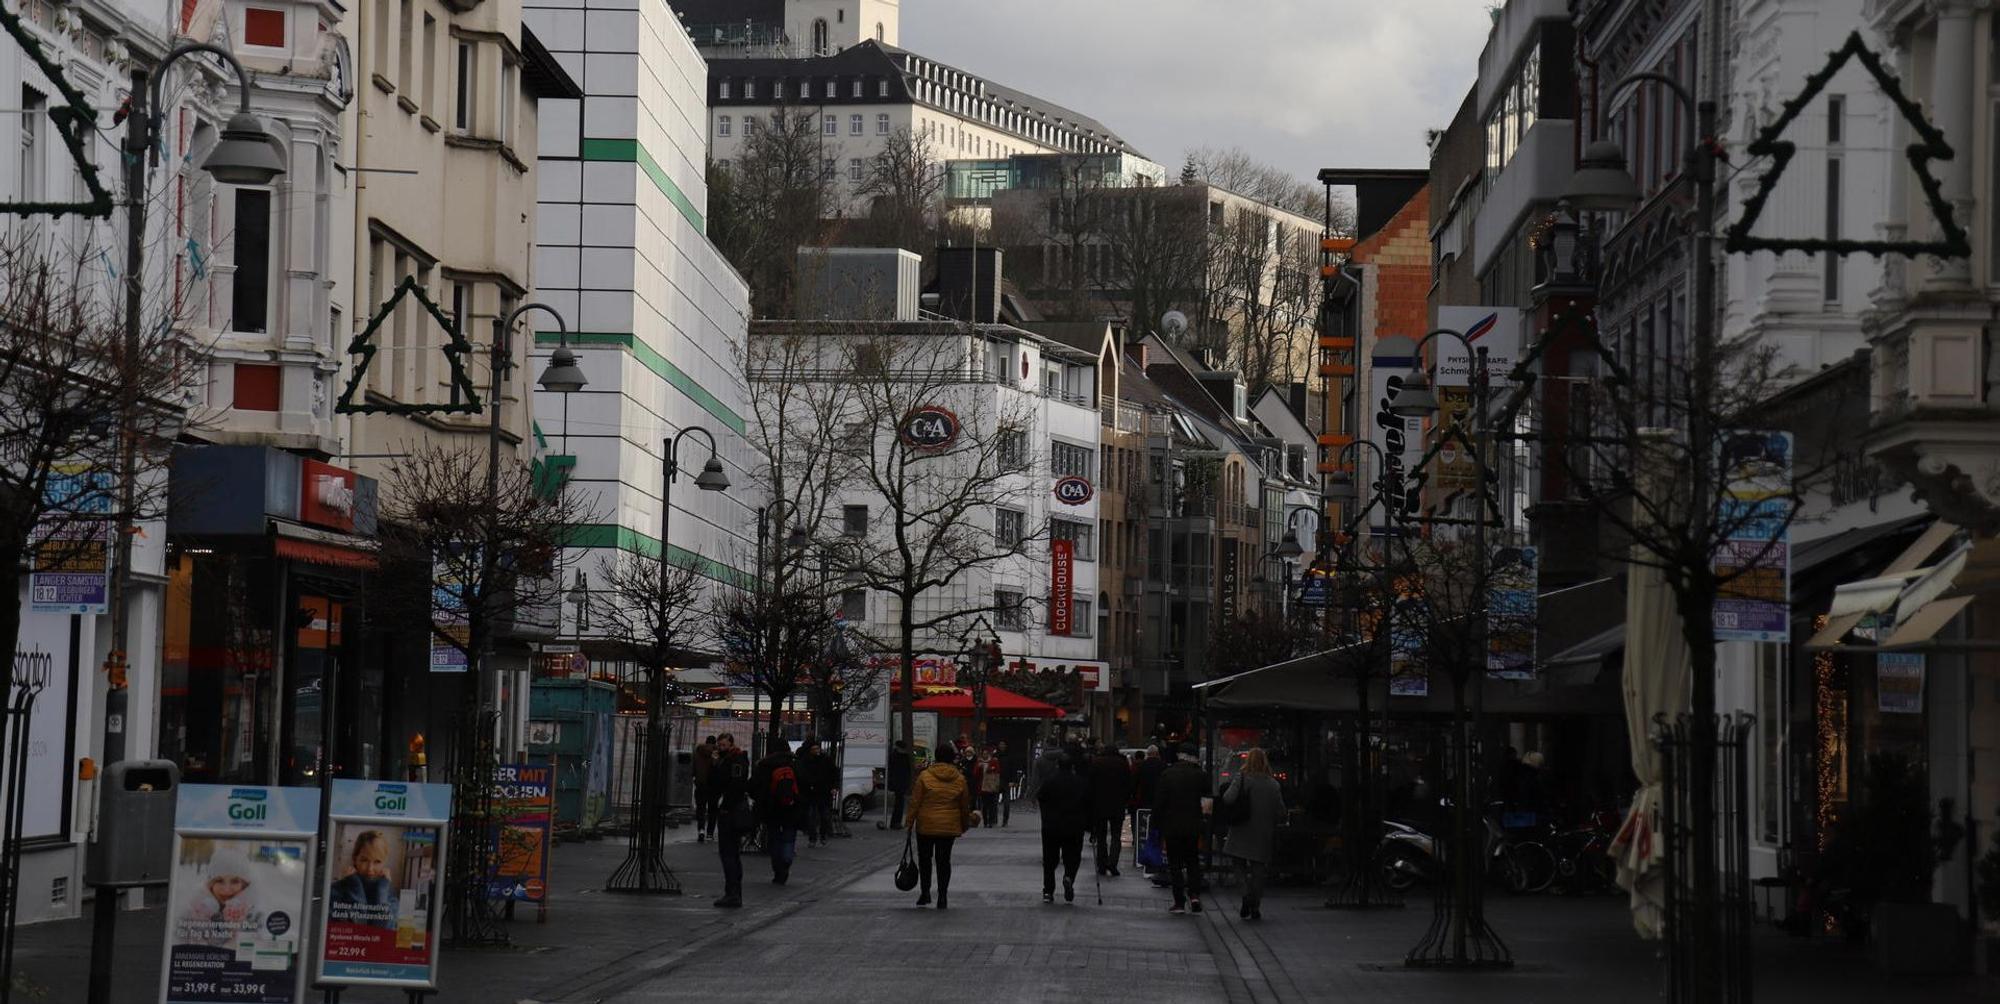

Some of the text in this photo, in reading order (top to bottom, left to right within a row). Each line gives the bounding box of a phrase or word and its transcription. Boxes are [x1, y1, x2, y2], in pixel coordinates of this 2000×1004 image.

[910, 417, 947, 438] C&A
[1061, 484, 1085, 498] C&A
[35, 575, 105, 586] LANGER SAMSTAG
[1056, 552, 1068, 631] CLOCKHOUSE
[518, 767, 549, 783] MIT
[375, 795, 406, 811] Goll
[228, 803, 266, 820] Goll
[361, 947, 367, 957] €
[184, 982, 209, 994] 31,99
[209, 982, 217, 993] €
[233, 983, 258, 995] 33,99
[259, 984, 266, 994] €
